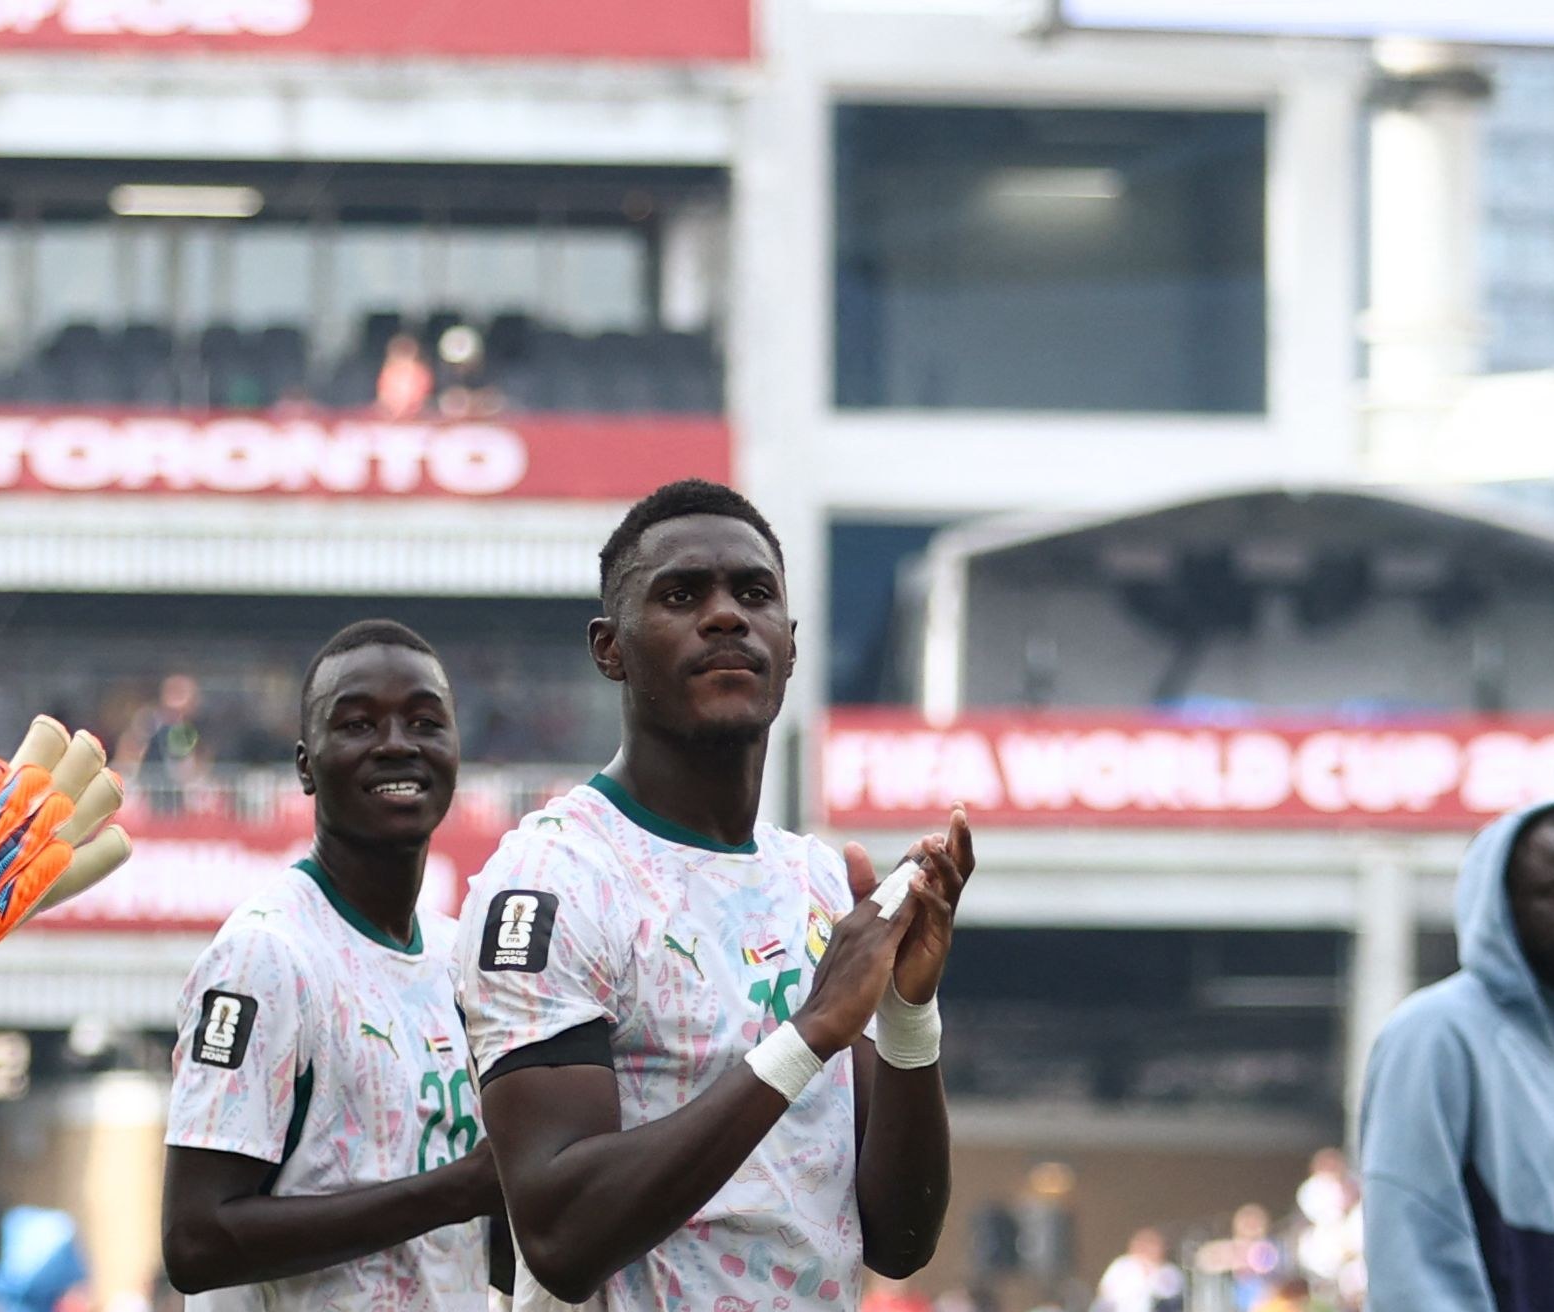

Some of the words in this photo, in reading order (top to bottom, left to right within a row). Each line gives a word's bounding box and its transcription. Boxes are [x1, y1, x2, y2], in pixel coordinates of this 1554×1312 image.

[825, 727, 1003, 810] FIFA
[998, 728, 1293, 812] WORLD
[1294, 730, 1461, 813] CUP
[418, 1069, 478, 1173] 26
